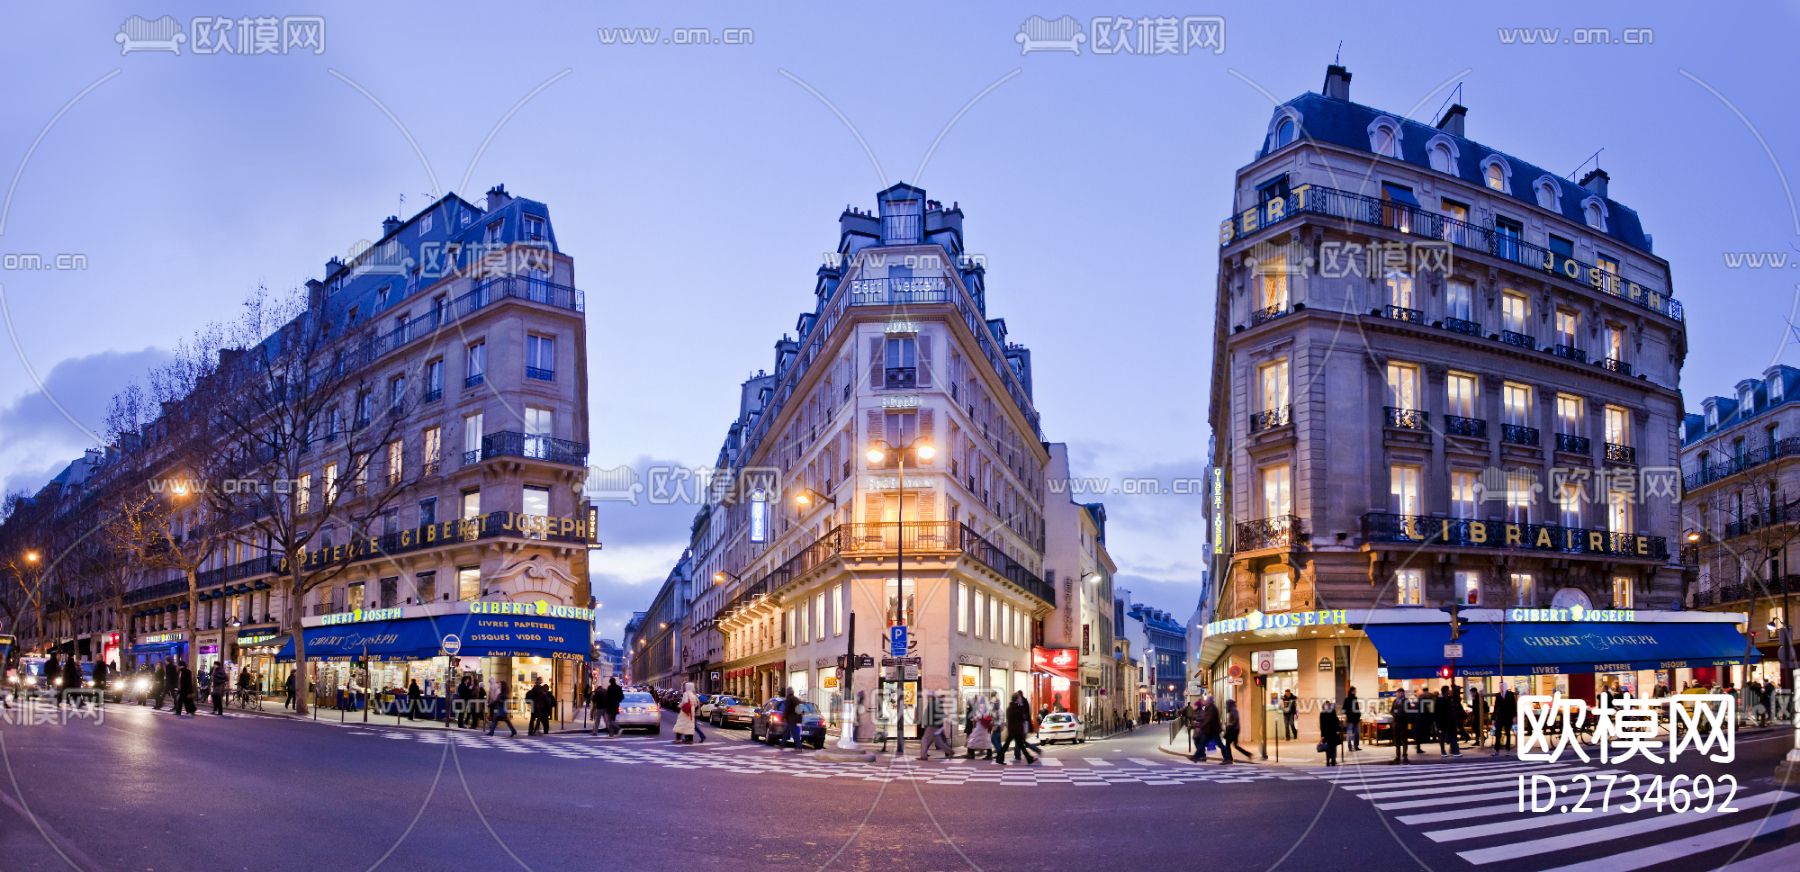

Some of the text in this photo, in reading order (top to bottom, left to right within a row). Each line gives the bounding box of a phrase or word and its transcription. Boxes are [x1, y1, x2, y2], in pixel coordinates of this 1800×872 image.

[1544, 249, 1661, 312] JOSEPH
[401, 513, 490, 547] GIBERT
[502, 512, 586, 540] JOSEPH
[1407, 519, 1648, 555] LIBRAIRIE
[321, 608, 401, 625] GIBERT JOSEPH
[470, 601, 594, 620] GIBERT JOSEPH
[1264, 609, 1346, 629] JOSEPH
[1512, 608, 1635, 622] GIBERT JOSEPH
[895, 629, 902, 639] P
[1523, 635, 1581, 646] GIBERT
[552, 652, 584, 660] OCCASION
[1532, 666, 1560, 674] LIVRES
